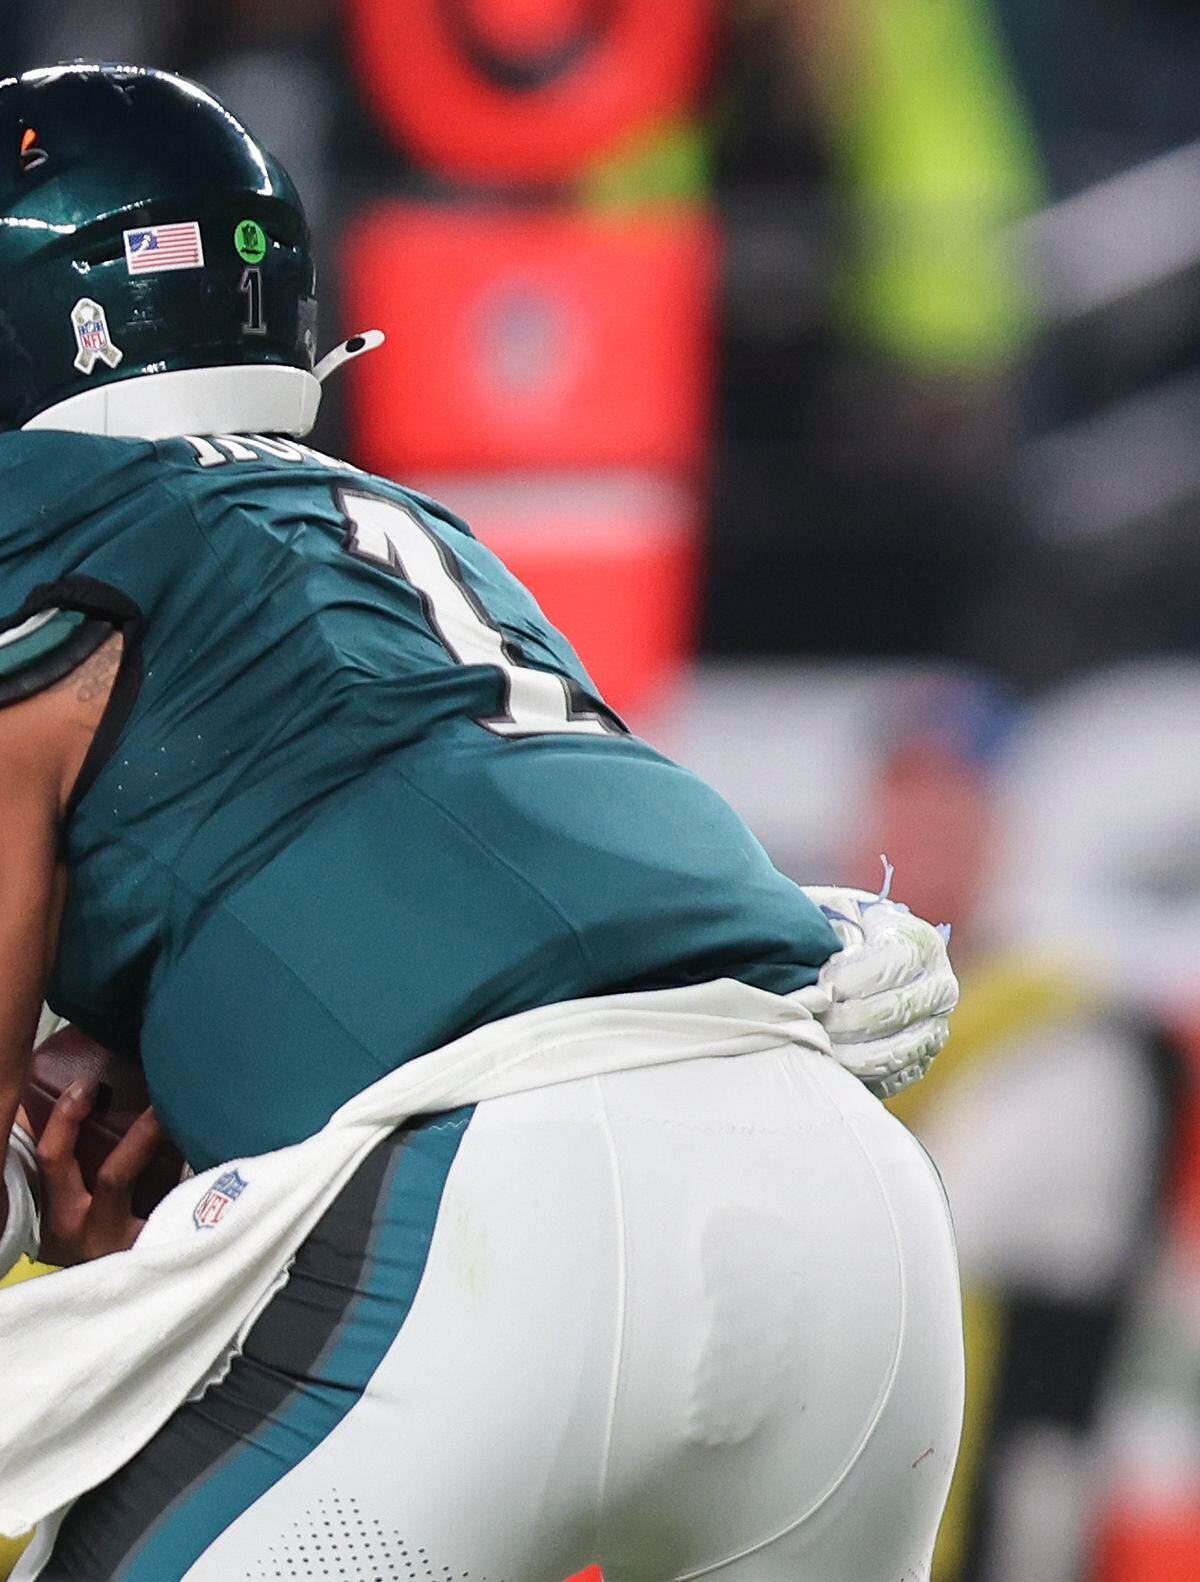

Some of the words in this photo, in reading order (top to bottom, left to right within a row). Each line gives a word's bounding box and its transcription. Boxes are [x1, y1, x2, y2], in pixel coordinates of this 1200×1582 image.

[241, 267, 267, 335] 1
[83, 333, 106, 348] NFL
[332, 486, 631, 741] 1
[197, 1193, 228, 1223] NFL
